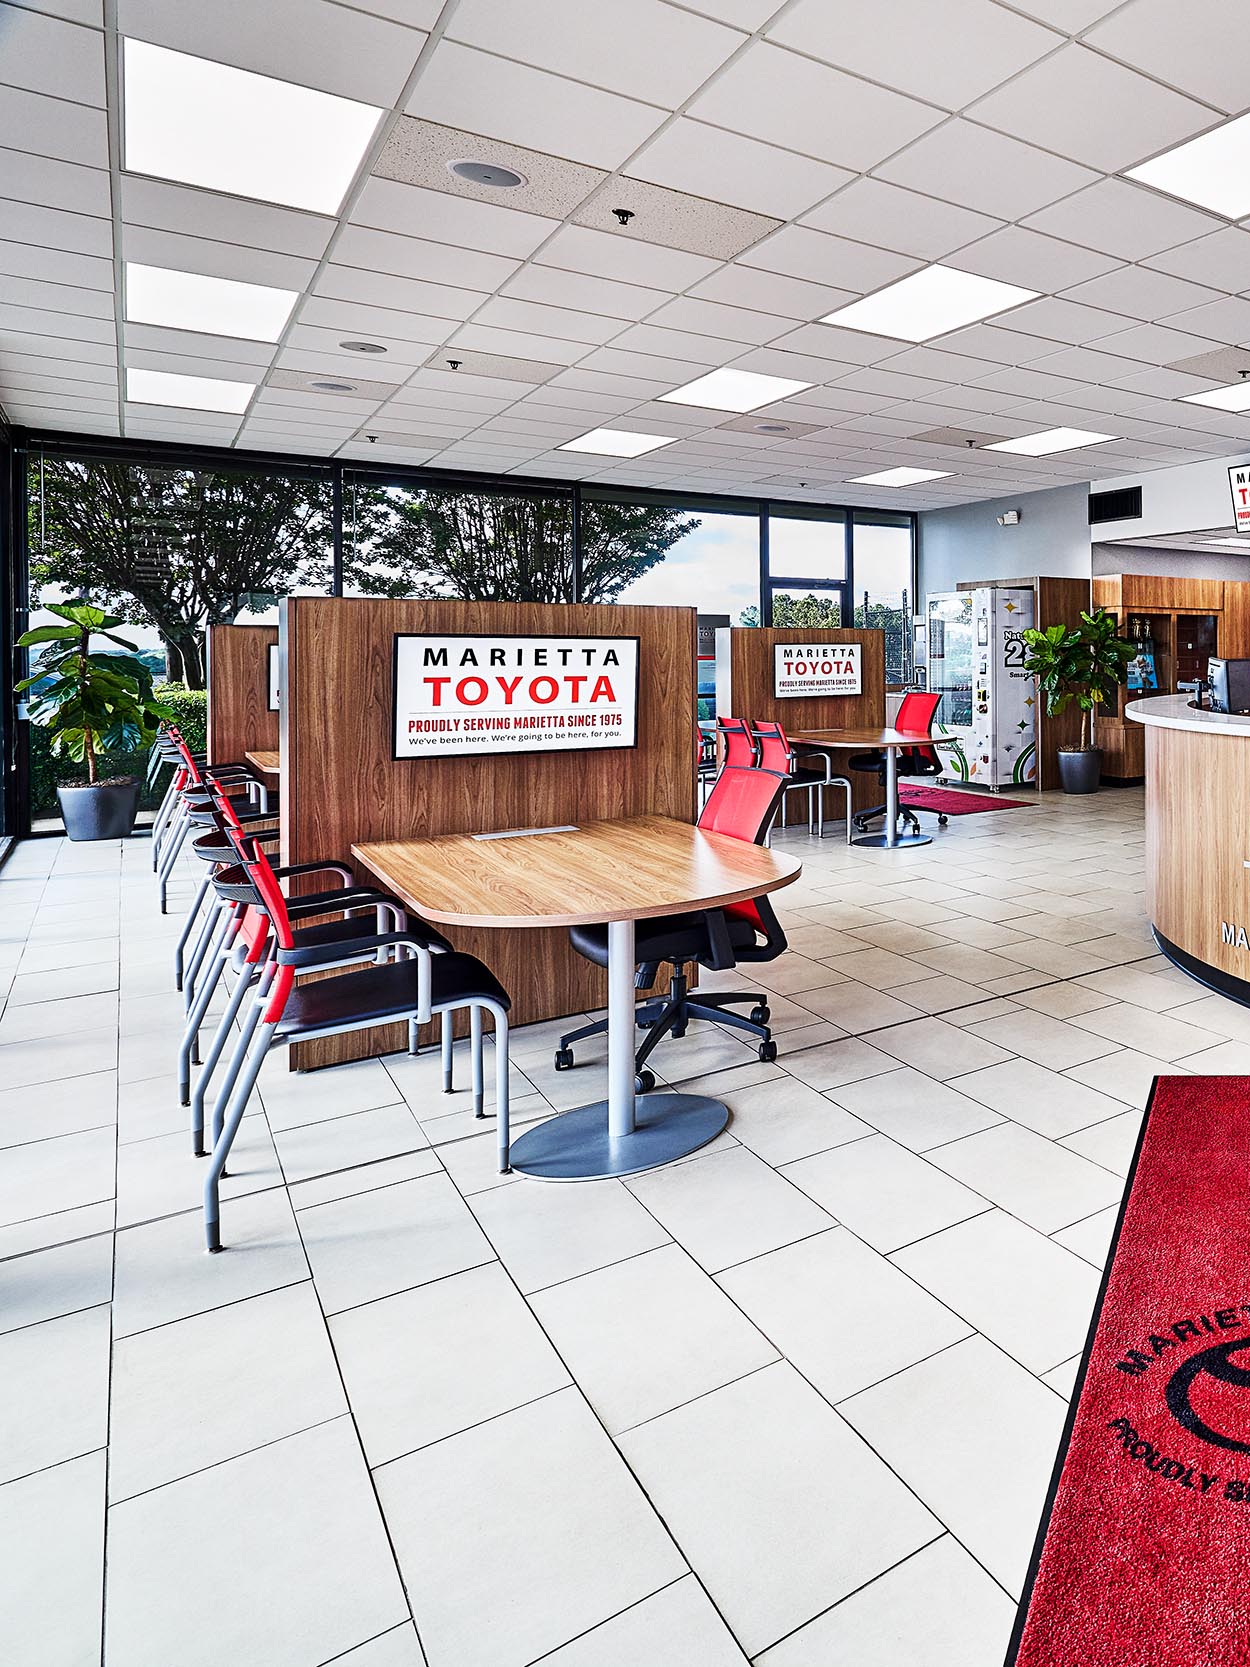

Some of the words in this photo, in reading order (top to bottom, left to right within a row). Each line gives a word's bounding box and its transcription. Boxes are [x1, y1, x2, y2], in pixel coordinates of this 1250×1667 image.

[423, 648, 619, 666] MARIETTA
[784, 649, 855, 658] MARIETTA
[784, 661, 854, 676] TOYOTA
[423, 675, 617, 706] TOYOTA
[408, 719, 461, 733] PROUDLY
[463, 718, 511, 731] SERVING
[513, 716, 565, 729] MARIETTA
[567, 715, 597, 727] SINCE
[600, 713, 622, 726] 1975
[491, 734, 517, 742] We're
[518, 733, 542, 742] going
[1107, 1416, 1217, 1494] PROUDLY
